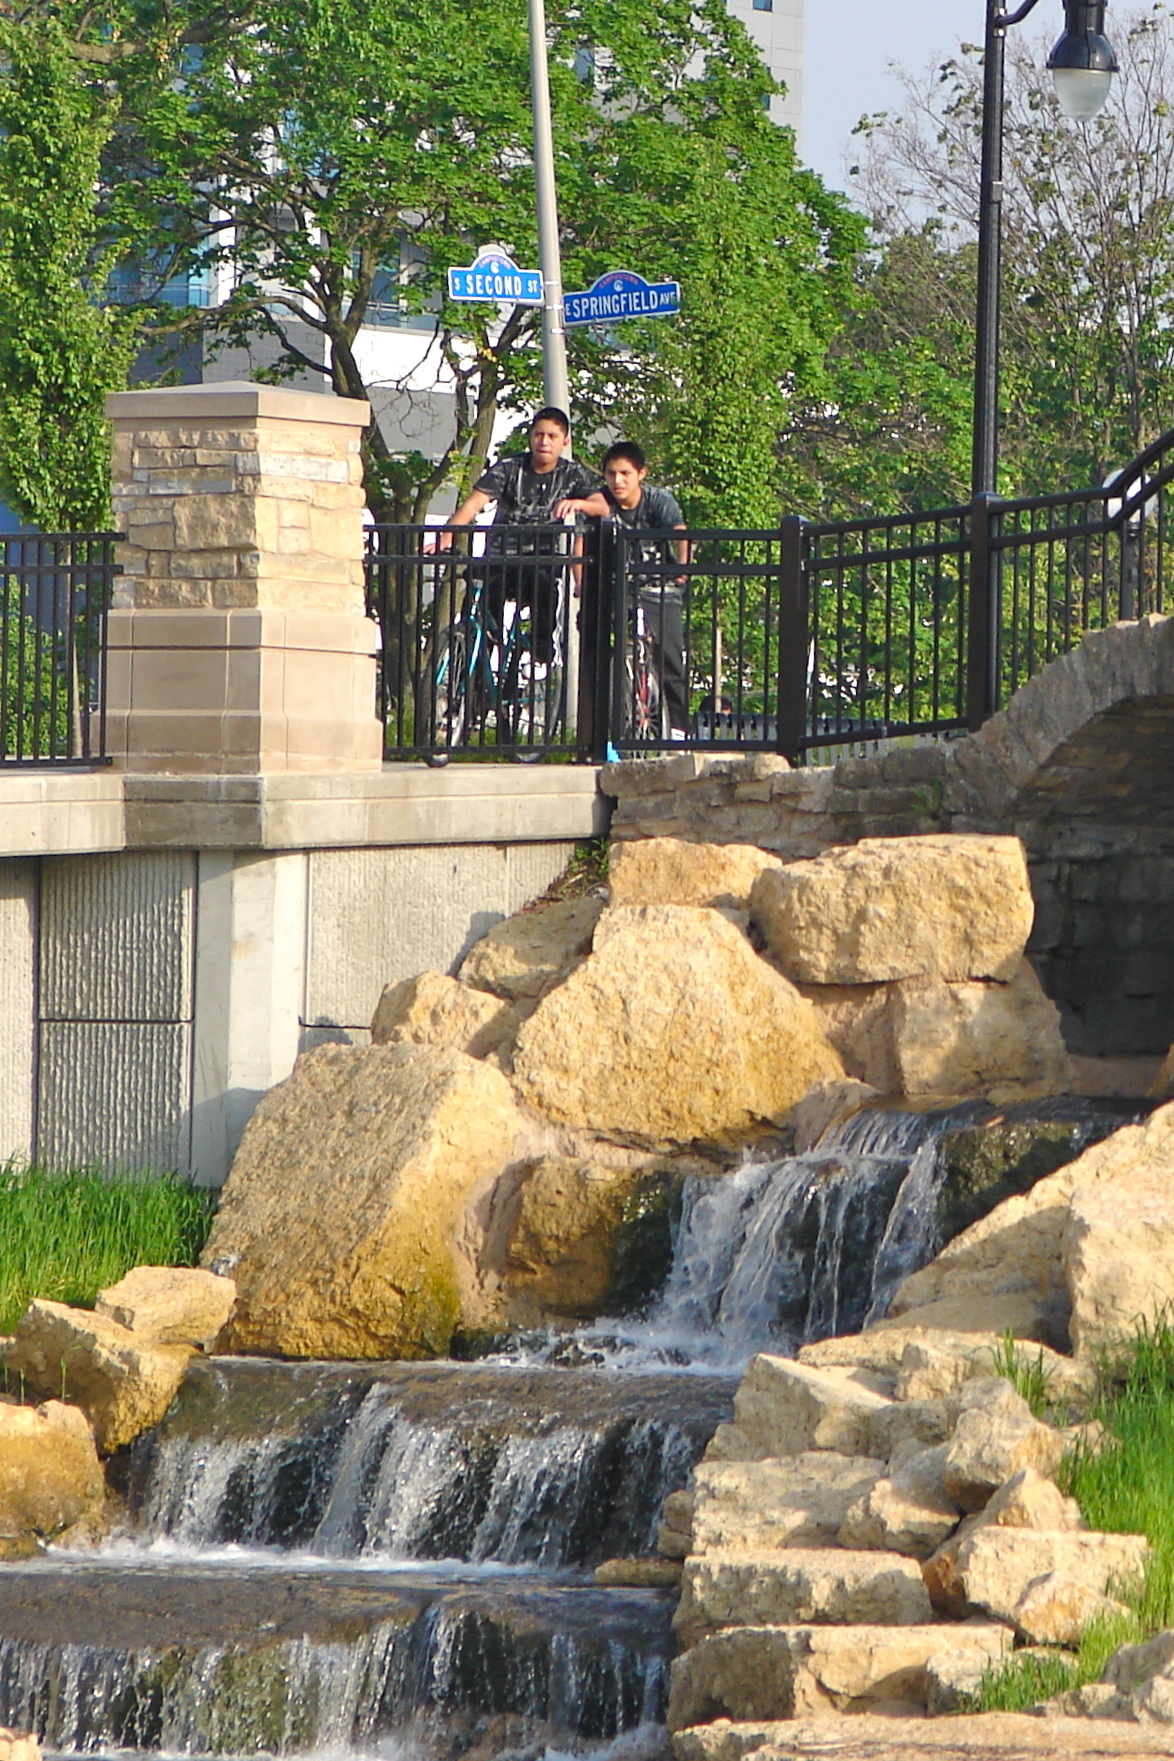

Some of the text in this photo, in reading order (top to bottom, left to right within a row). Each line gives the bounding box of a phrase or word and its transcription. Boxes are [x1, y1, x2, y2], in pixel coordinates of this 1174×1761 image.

[454, 274, 538, 296] S SECOND ST
[565, 303, 571, 316] E
[572, 290, 658, 319] SPRINGFIELD
